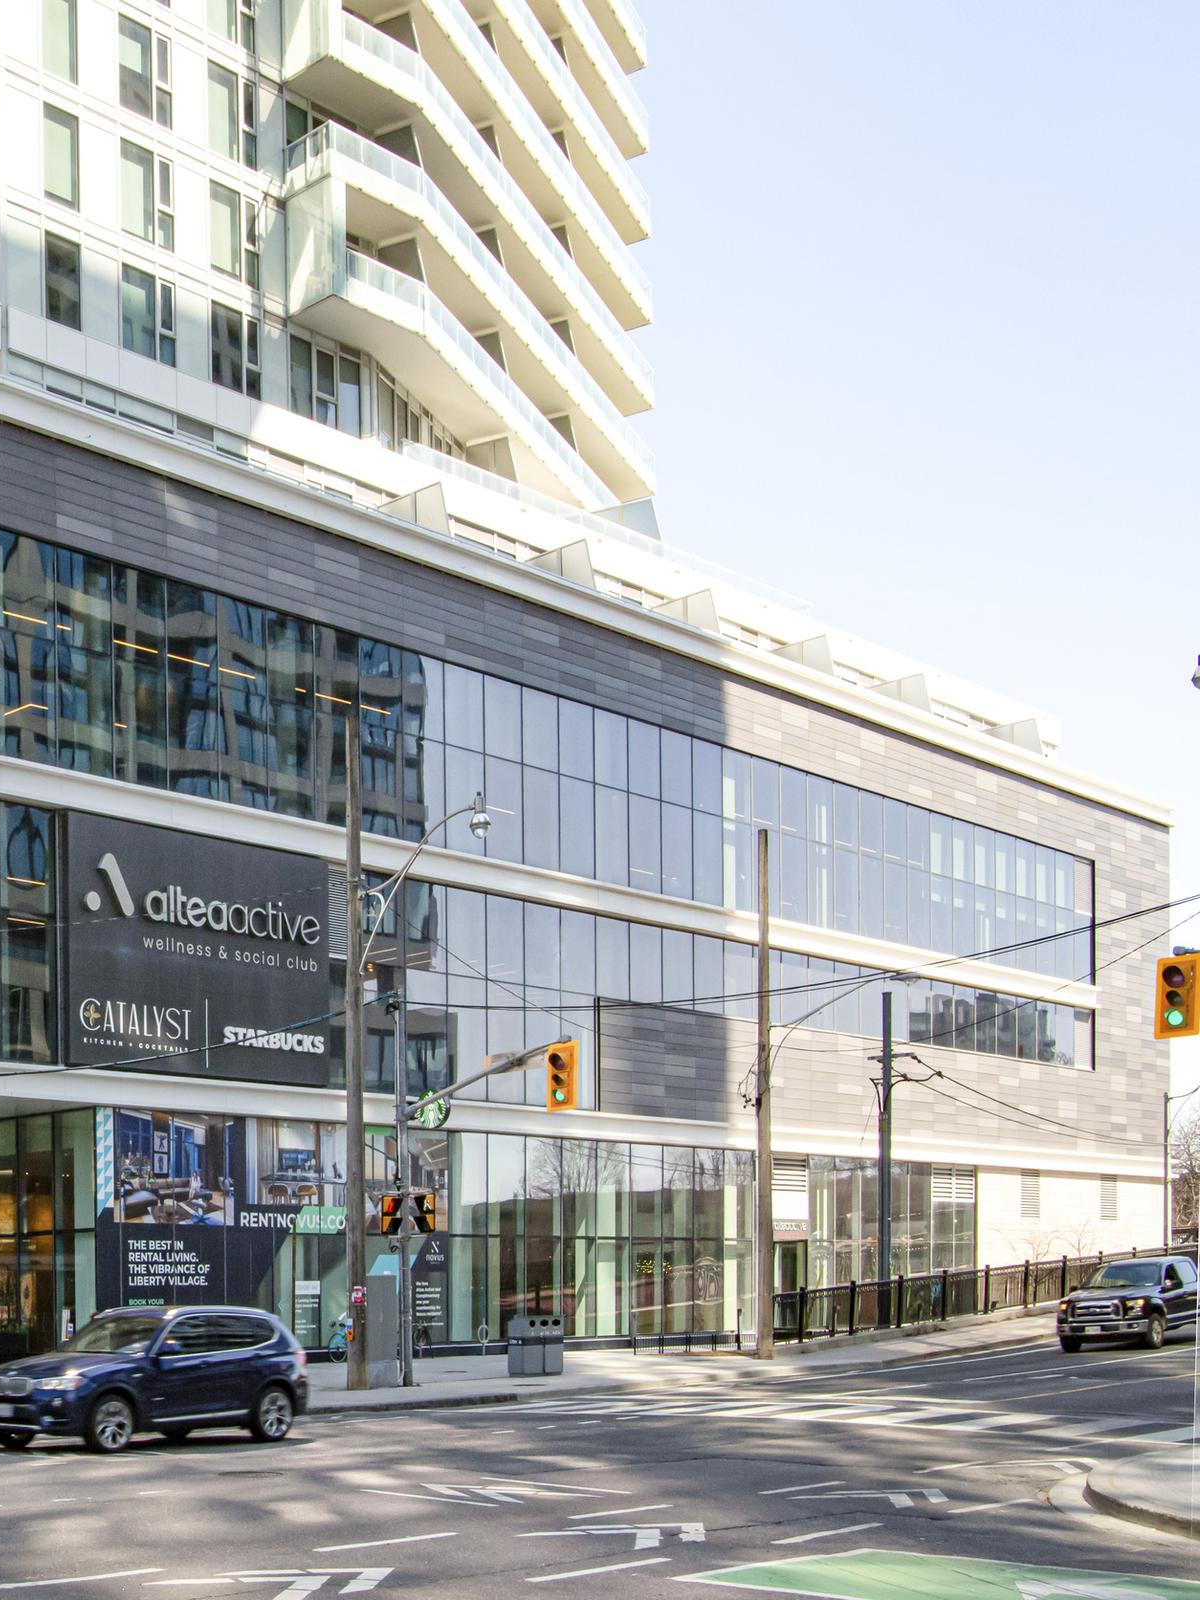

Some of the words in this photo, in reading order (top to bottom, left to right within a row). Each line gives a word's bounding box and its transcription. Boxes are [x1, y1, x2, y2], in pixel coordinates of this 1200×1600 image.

[145, 885, 320, 945] alteaactive
[143, 936, 212, 957] wellness
[218, 945, 228, 960] &
[235, 950, 280, 967] social
[286, 956, 318, 972] club
[80, 998, 192, 1041] CATALYST
[83, 1037, 123, 1047] KITCHEN
[138, 1043, 189, 1052] COCKTAILS
[224, 1026, 325, 1054] STARBUCKS
[240, 1211, 347, 1230] RENTNOVUS.CO
[128, 1240, 147, 1251] THE
[149, 1240, 172, 1251] BEST
[174, 1241, 184, 1251] IN
[128, 1252, 165, 1262] RENTAL
[166, 1252, 199, 1262] LIVING.
[426, 1254, 445, 1262] novus
[128, 1264, 147, 1274] THE
[149, 1264, 196, 1274] VIBRANCE
[197, 1264, 210, 1274] OF
[128, 1276, 167, 1286] LIBERTY
[168, 1276, 208, 1286] VILLAGE.
